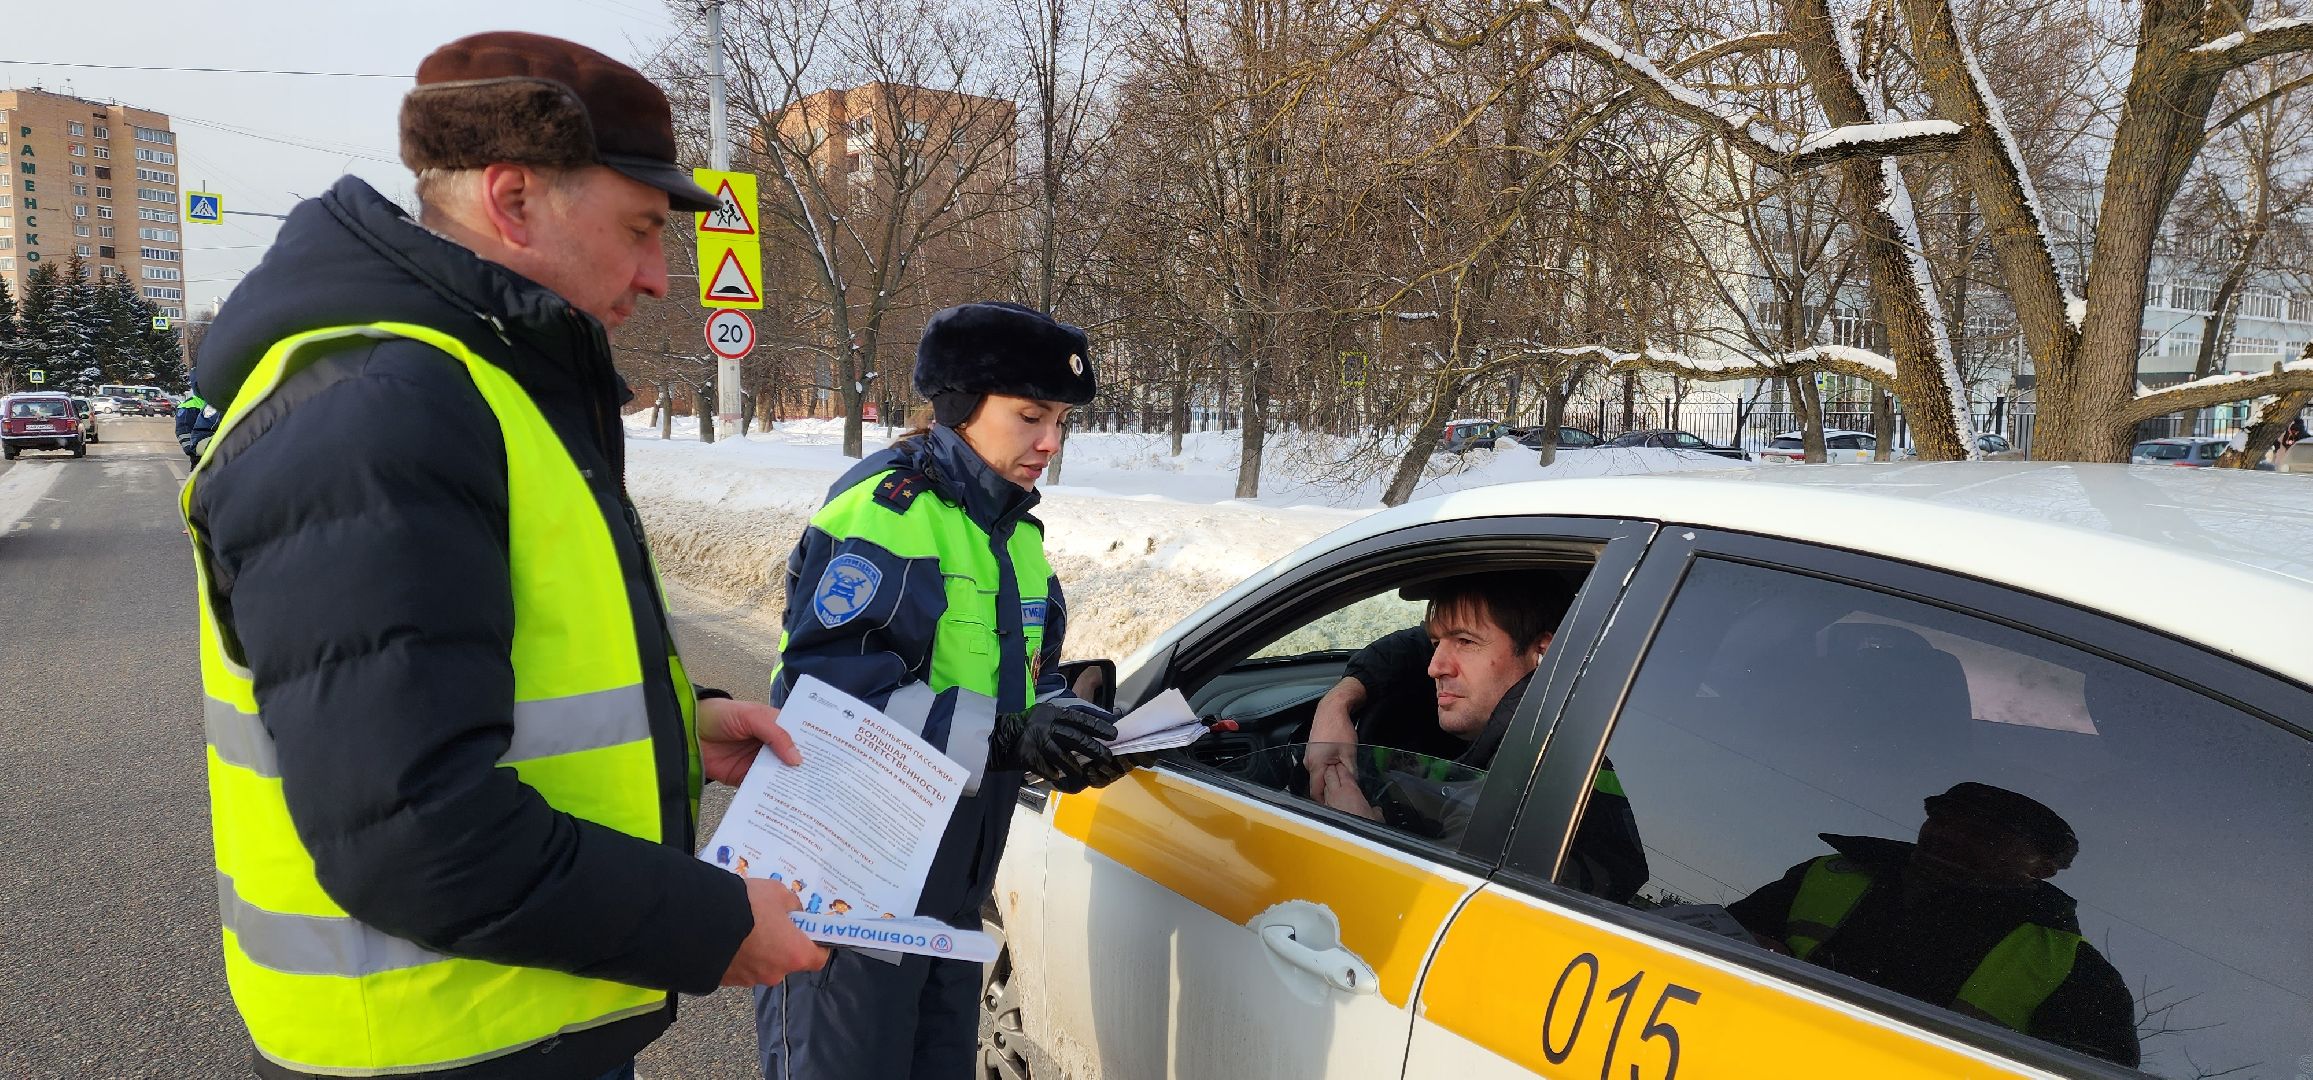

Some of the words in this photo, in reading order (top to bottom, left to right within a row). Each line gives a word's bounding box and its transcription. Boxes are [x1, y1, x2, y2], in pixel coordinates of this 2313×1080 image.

[718, 324, 742, 343] 20
[831, 557, 878, 582] ЛИЦИЯ
[857, 726, 906, 760] БОЛЬШАЯ
[862, 717, 912, 752] МАЛЕНЬКИЙ
[913, 750, 952, 782] ПАССАЖИР
[854, 733, 945, 802] ОТВЕТСТВЕННОСТЬ!
[822, 924, 926, 947] СОБЛЮДАЙ
[1542, 952, 1702, 1080] 015
